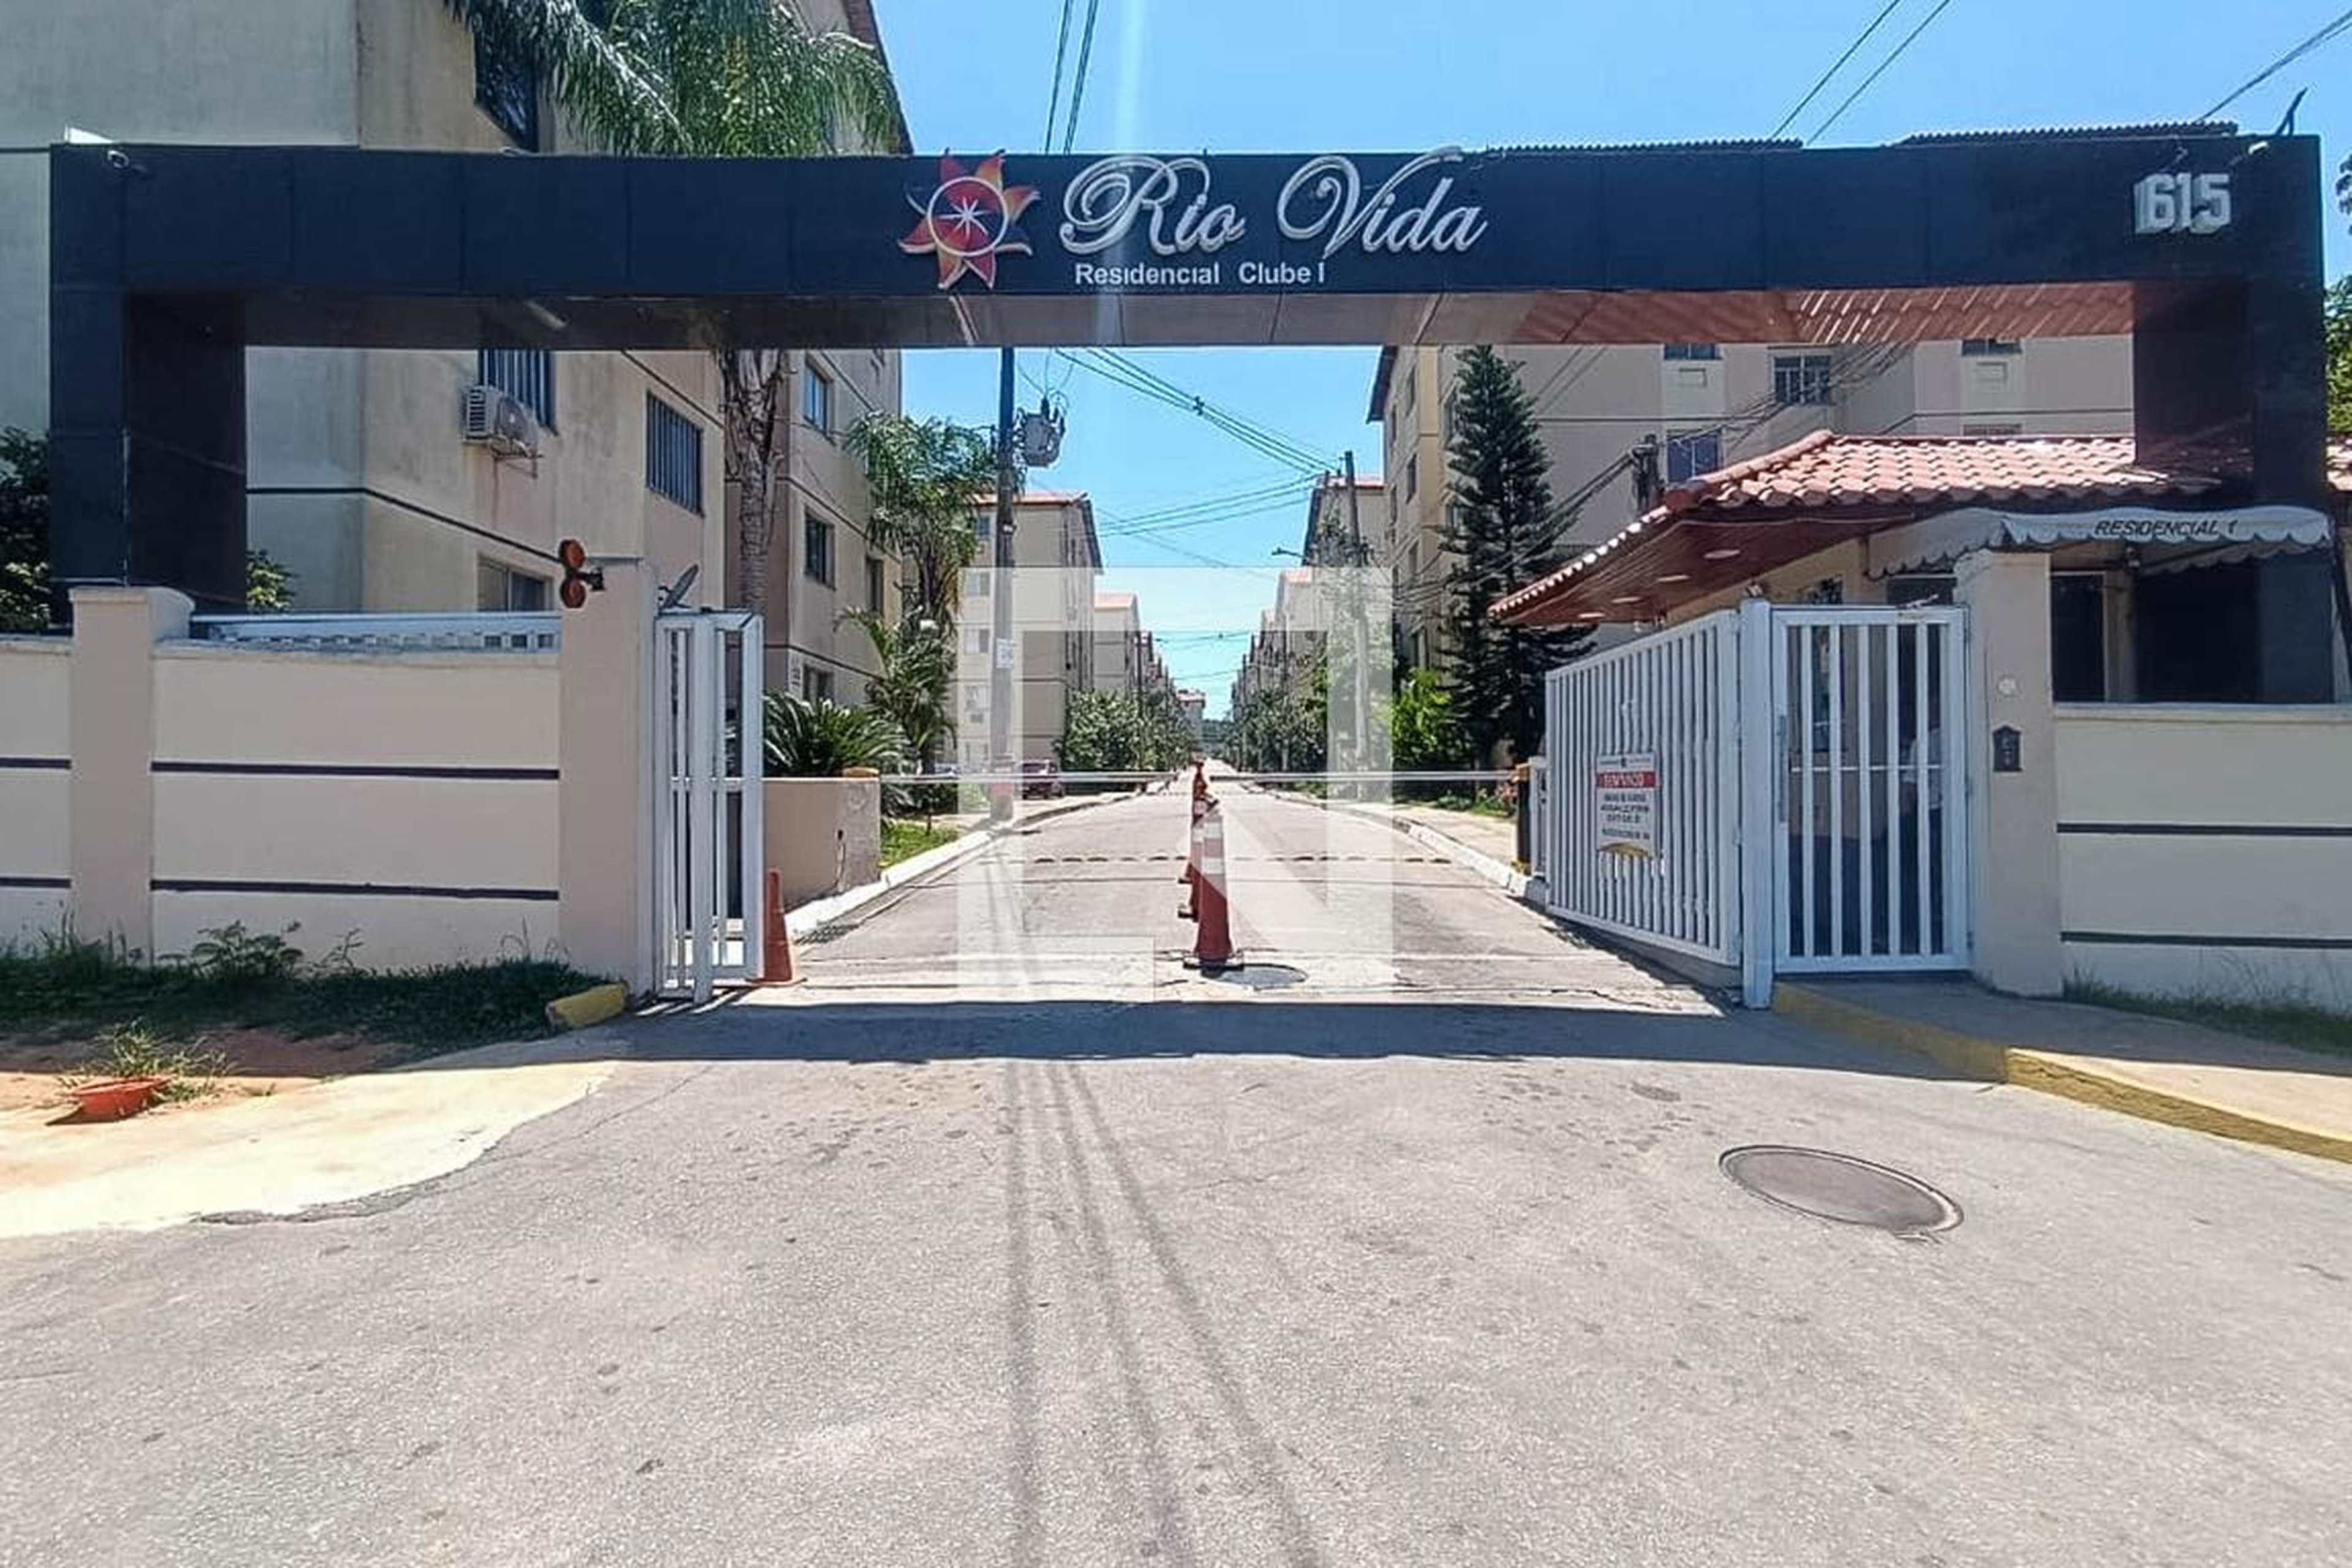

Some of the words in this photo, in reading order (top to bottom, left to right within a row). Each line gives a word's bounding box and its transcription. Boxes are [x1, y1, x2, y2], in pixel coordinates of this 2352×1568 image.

[1060, 155, 1245, 255] Rio
[1277, 146, 1488, 259] Vida
[2135, 172, 2231, 234] 615
[1075, 262, 1219, 284] Residencial
[1238, 262, 1311, 284] Clube
[2094, 519, 2218, 536] RESIDENCIAL
